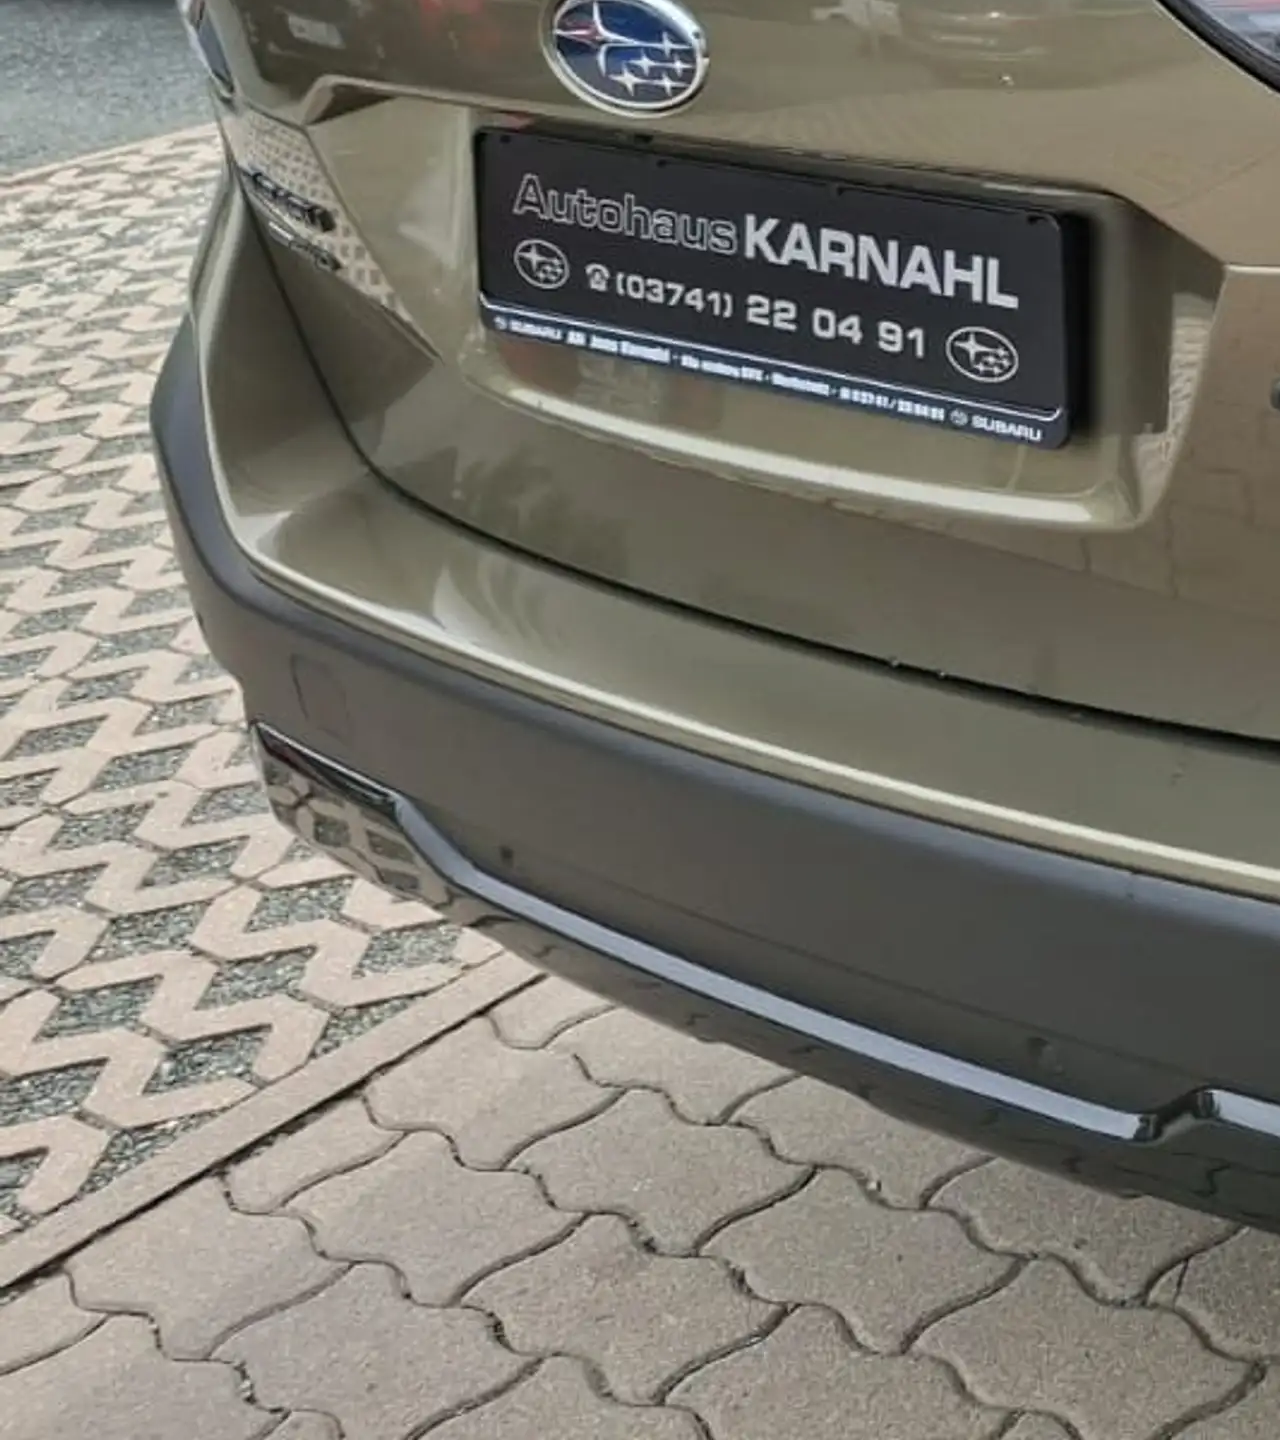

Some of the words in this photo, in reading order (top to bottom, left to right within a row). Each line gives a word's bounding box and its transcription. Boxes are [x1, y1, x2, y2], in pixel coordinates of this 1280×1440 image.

[512, 173, 738, 255] Autohaus
[744, 213, 1019, 309] KARNAHL
[615, 270, 733, 319] (03741)
[746, 294, 797, 331] 22
[812, 308, 863, 345] 04
[877, 320, 925, 359] 91
[970, 416, 1043, 442] SUBARU
